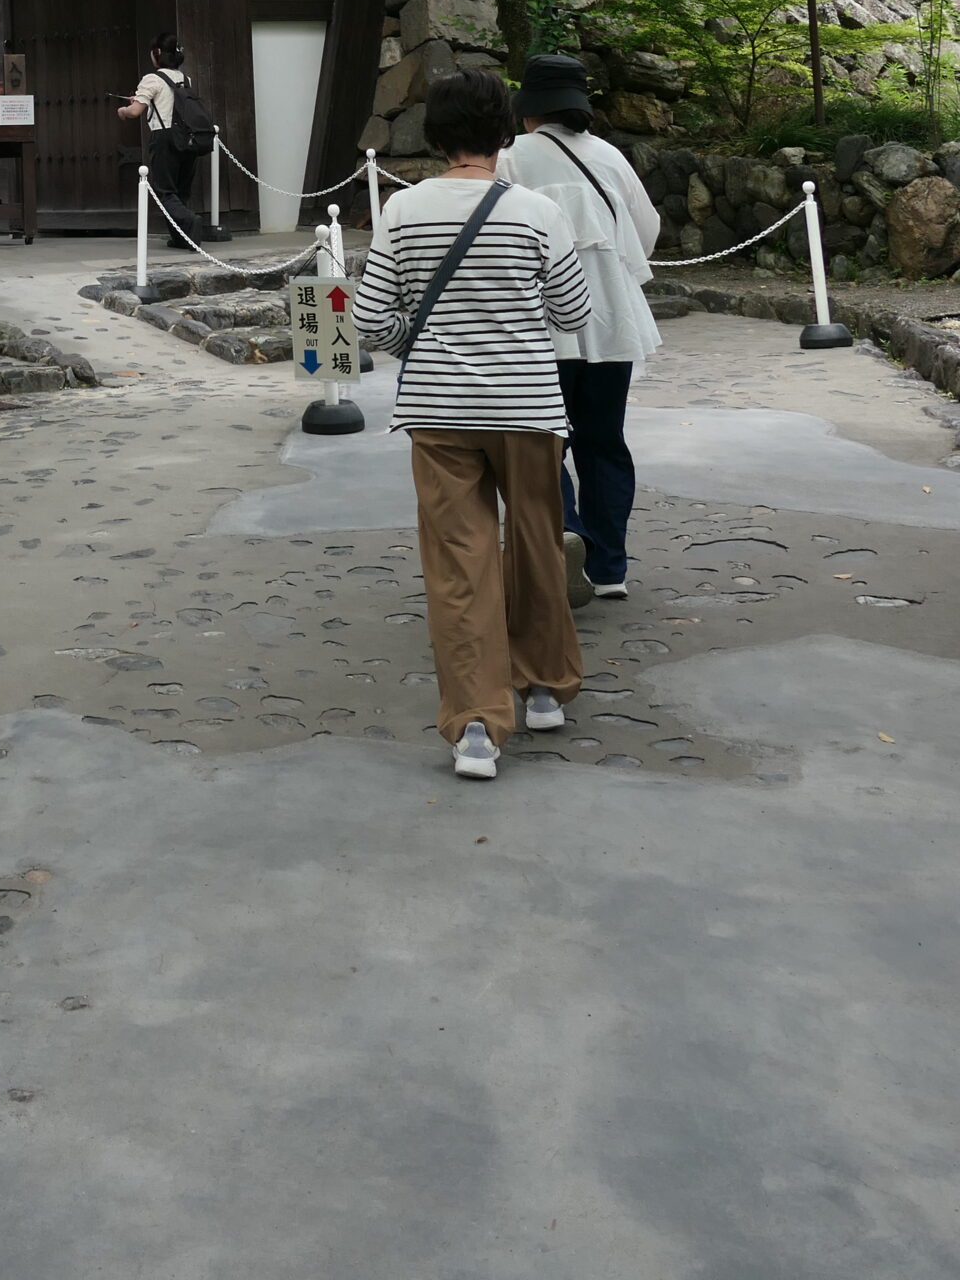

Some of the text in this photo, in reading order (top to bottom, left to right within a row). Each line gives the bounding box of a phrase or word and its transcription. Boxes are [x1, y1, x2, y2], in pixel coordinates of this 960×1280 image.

[9, 62, 23, 88] 入口
[297, 286, 319, 334] 退場
[336, 315, 344, 323] IN
[305, 338, 318, 347] OUT
[331, 326, 352, 375] 入場
